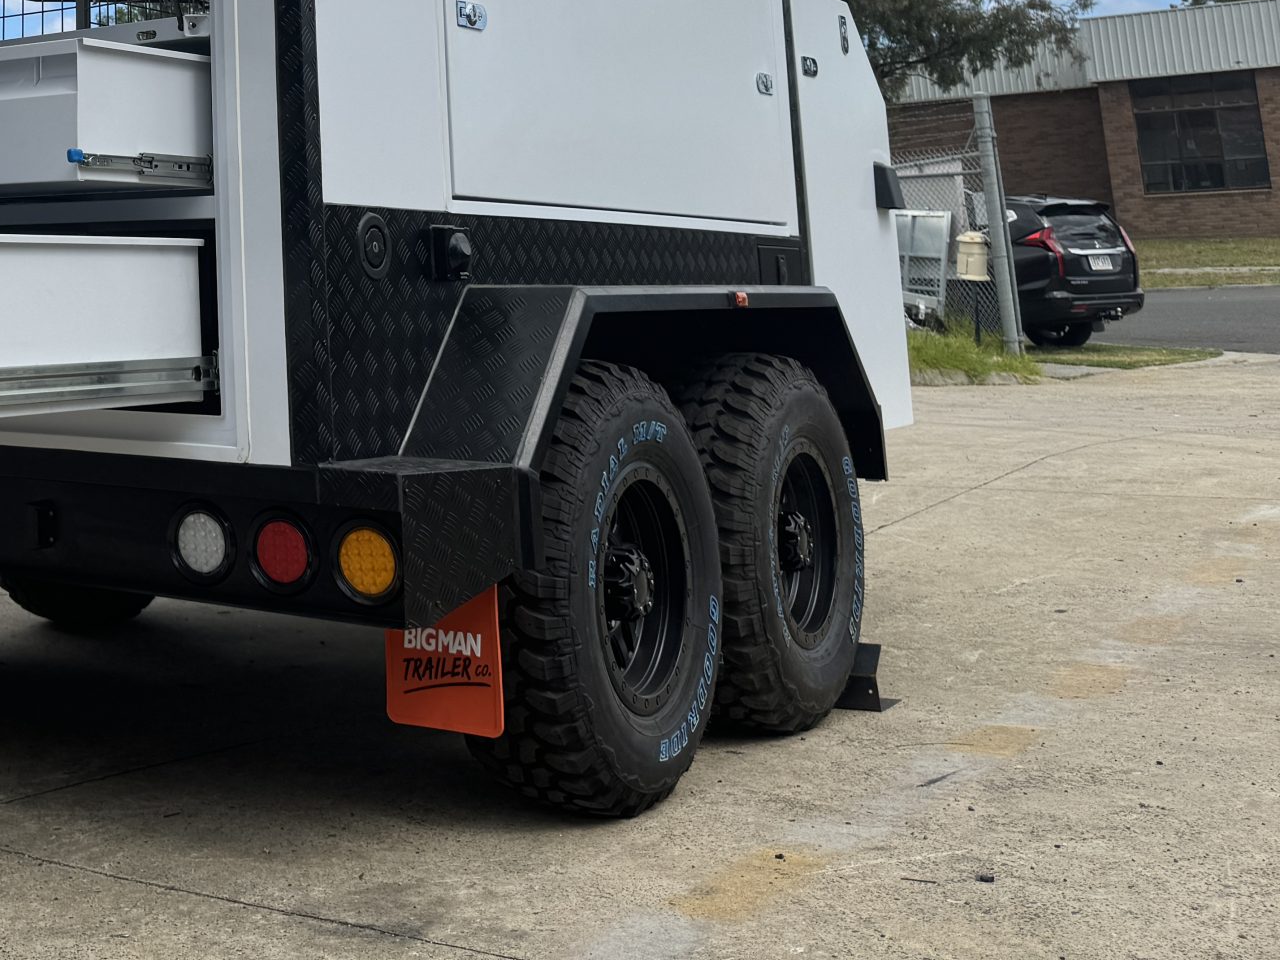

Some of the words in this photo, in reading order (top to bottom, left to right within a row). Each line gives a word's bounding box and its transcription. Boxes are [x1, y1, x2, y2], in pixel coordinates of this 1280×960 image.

[588, 438, 627, 589] RADIAL
[633, 421, 667, 444] M/T
[842, 456, 864, 644] GOODRIDE
[403, 657, 471, 681] TRAILER
[475, 664, 491, 677] CO.
[659, 595, 718, 762] GOODRIDE
